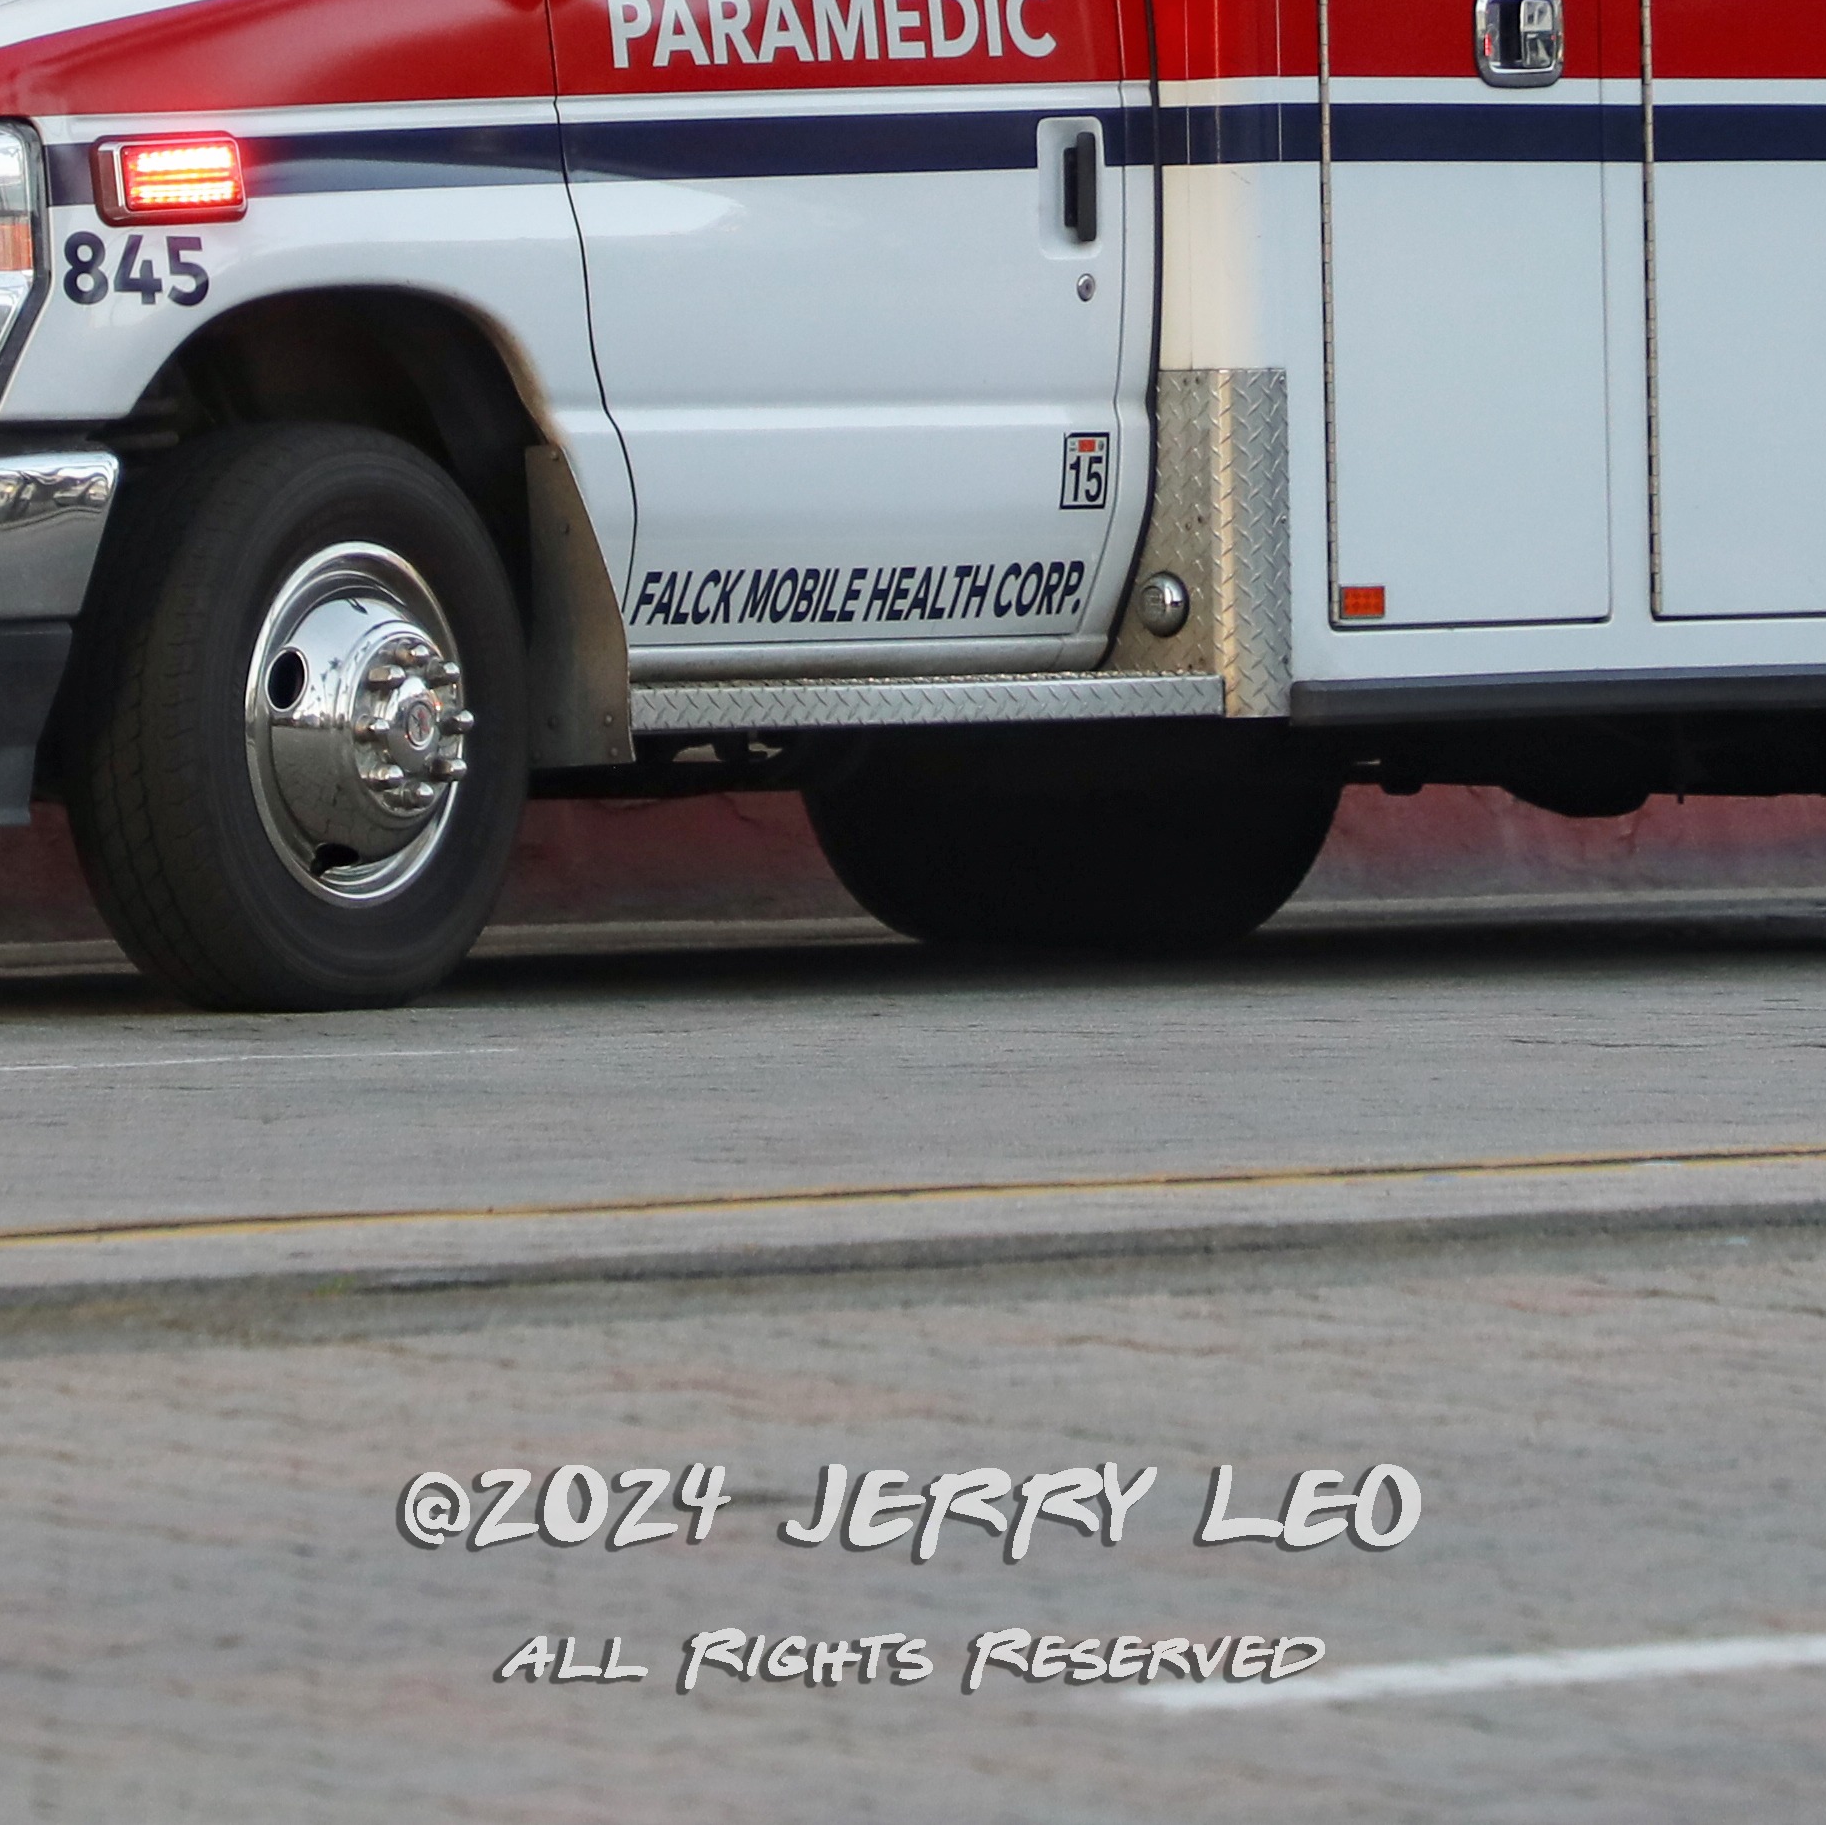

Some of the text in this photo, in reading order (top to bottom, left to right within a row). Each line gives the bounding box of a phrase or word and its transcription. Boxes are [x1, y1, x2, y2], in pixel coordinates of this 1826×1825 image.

[62, 231, 210, 308] 845
[1068, 455, 1104, 503] 15
[629, 560, 1087, 626] FALCK MOBILE HEALTH CORP.
